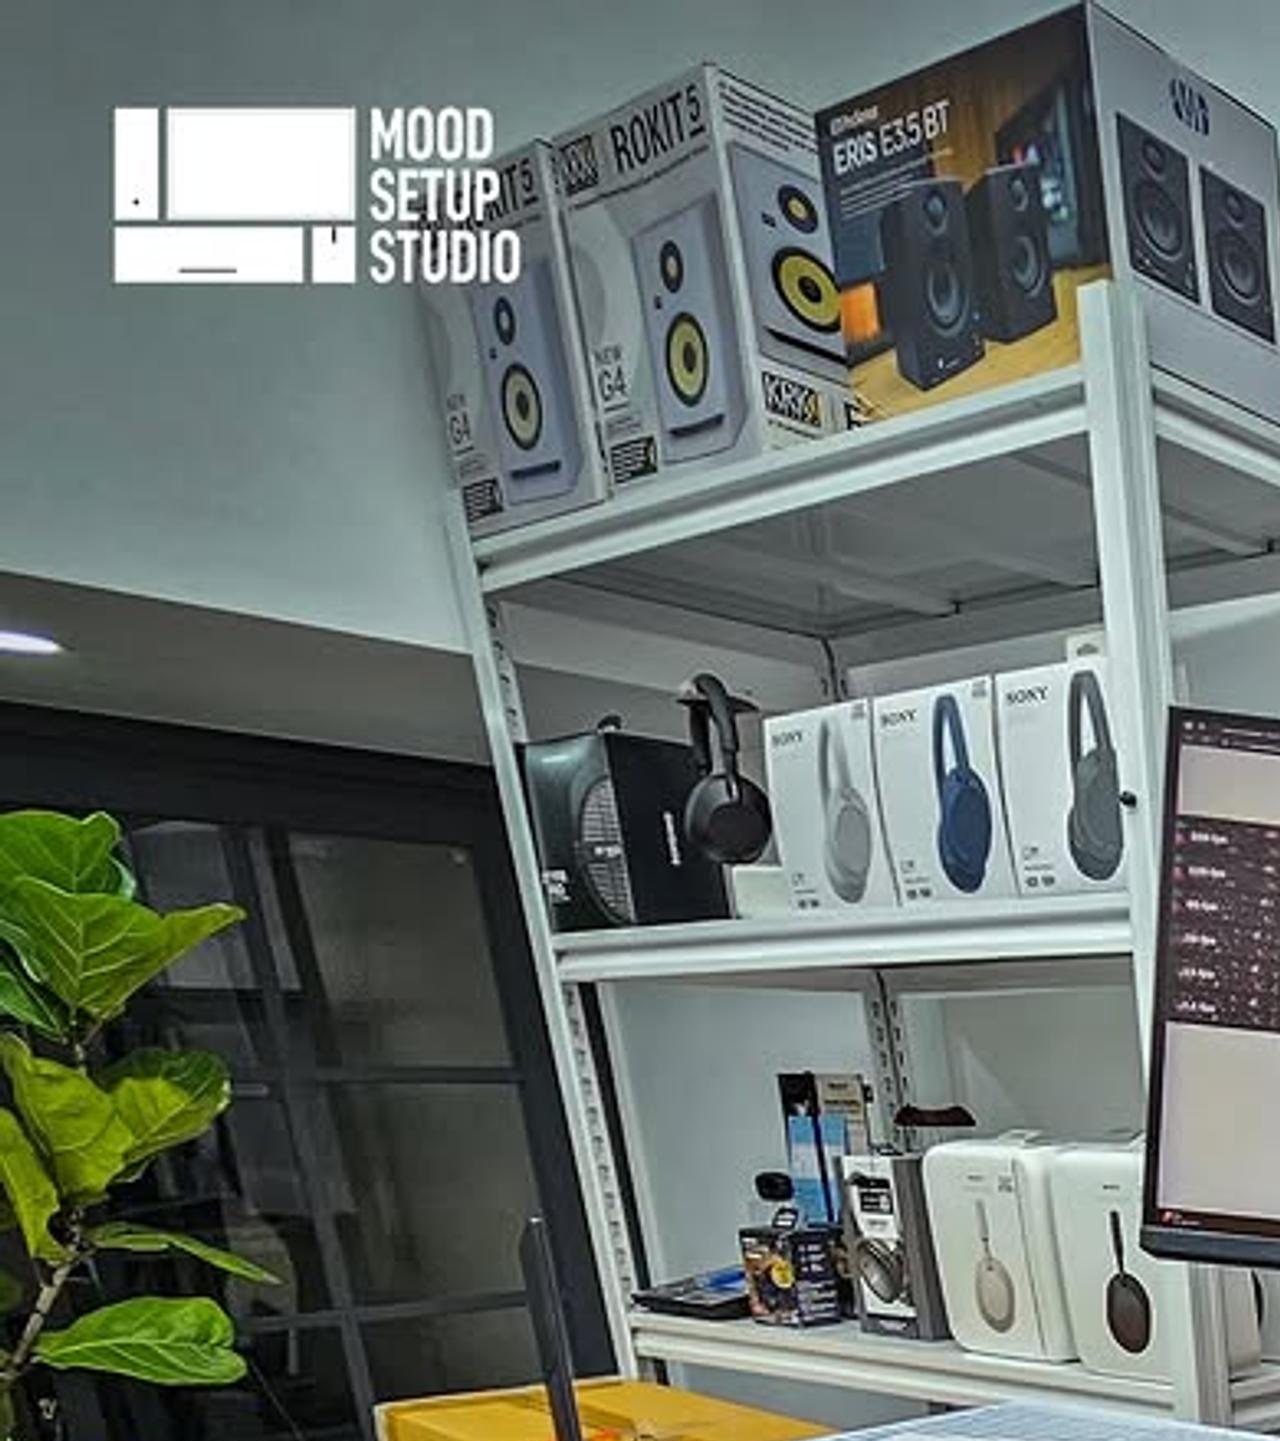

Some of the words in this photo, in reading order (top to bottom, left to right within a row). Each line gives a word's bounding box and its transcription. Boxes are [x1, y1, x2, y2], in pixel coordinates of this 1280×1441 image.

[610, 92, 684, 173] ROKIT
[833, 131, 878, 175] ERIS
[880, 111, 921, 156] E3.5
[922, 98, 950, 139] BT
[599, 364, 626, 401] G4
